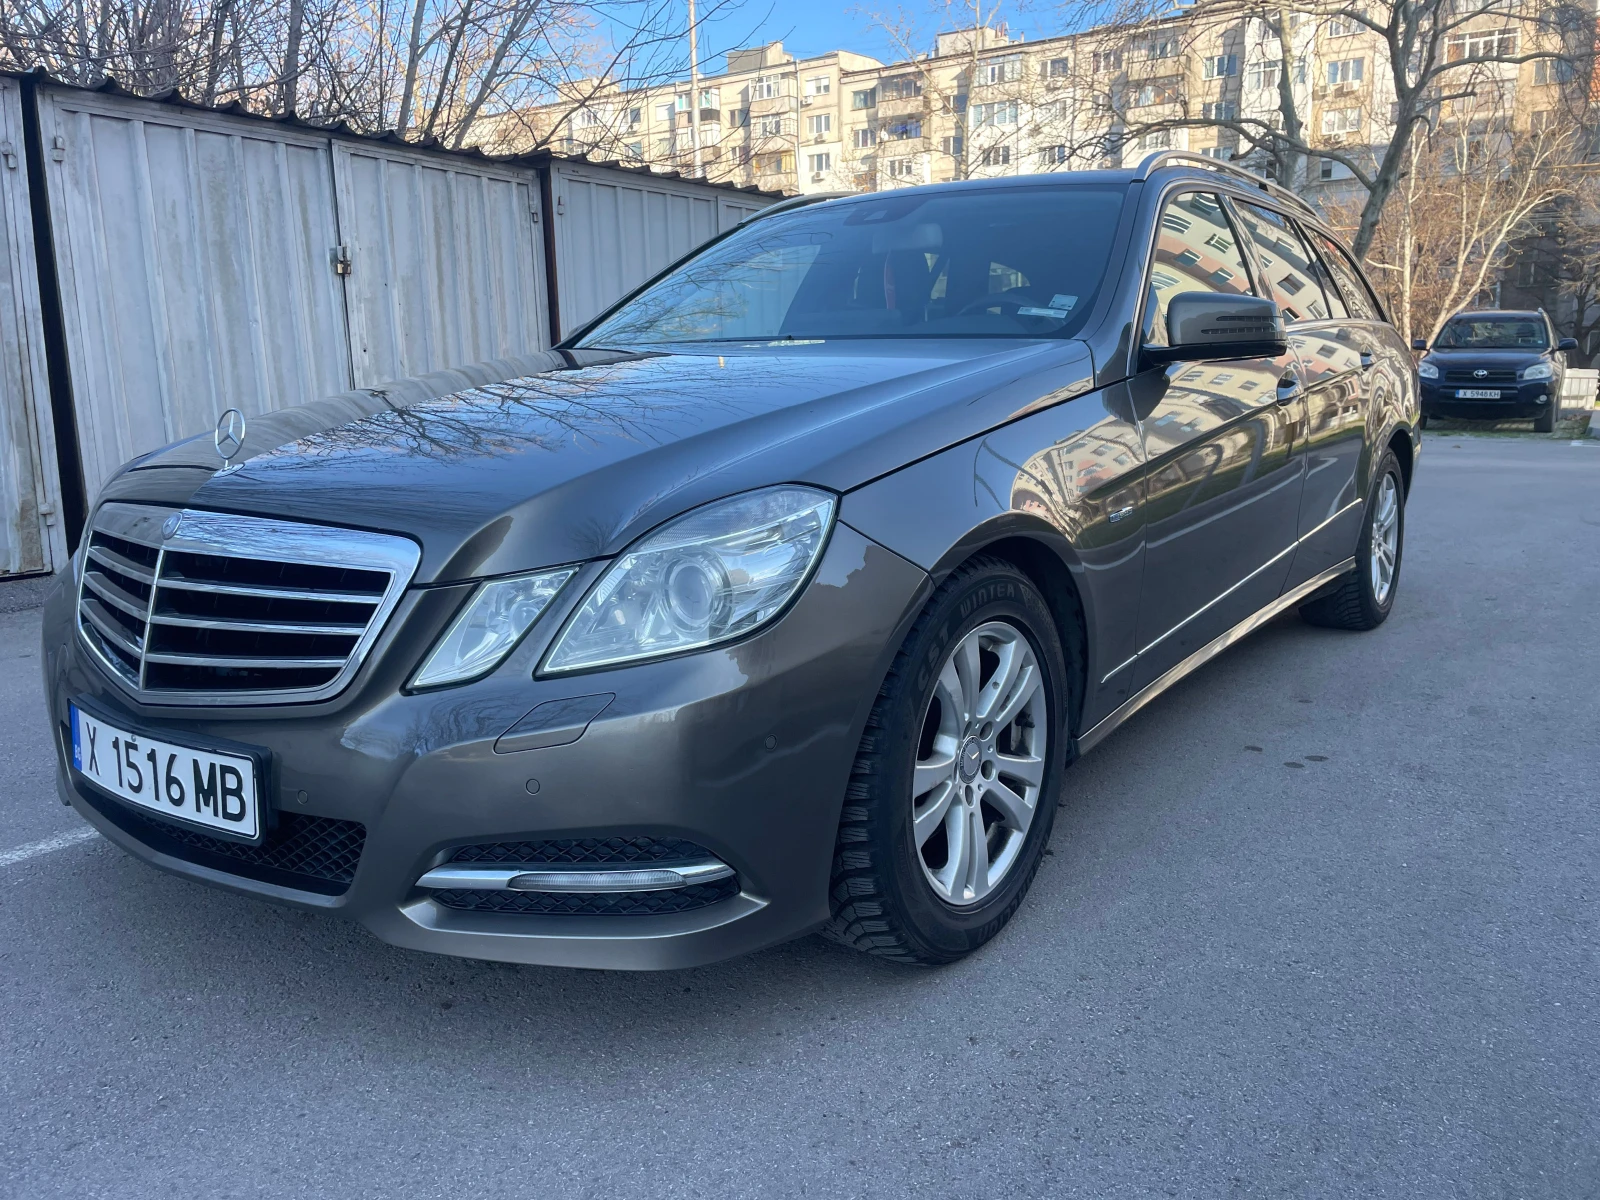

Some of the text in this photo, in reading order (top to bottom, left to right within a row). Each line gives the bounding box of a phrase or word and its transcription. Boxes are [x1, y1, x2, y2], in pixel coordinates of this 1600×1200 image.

[86, 721, 247, 822] X 1516 MB
